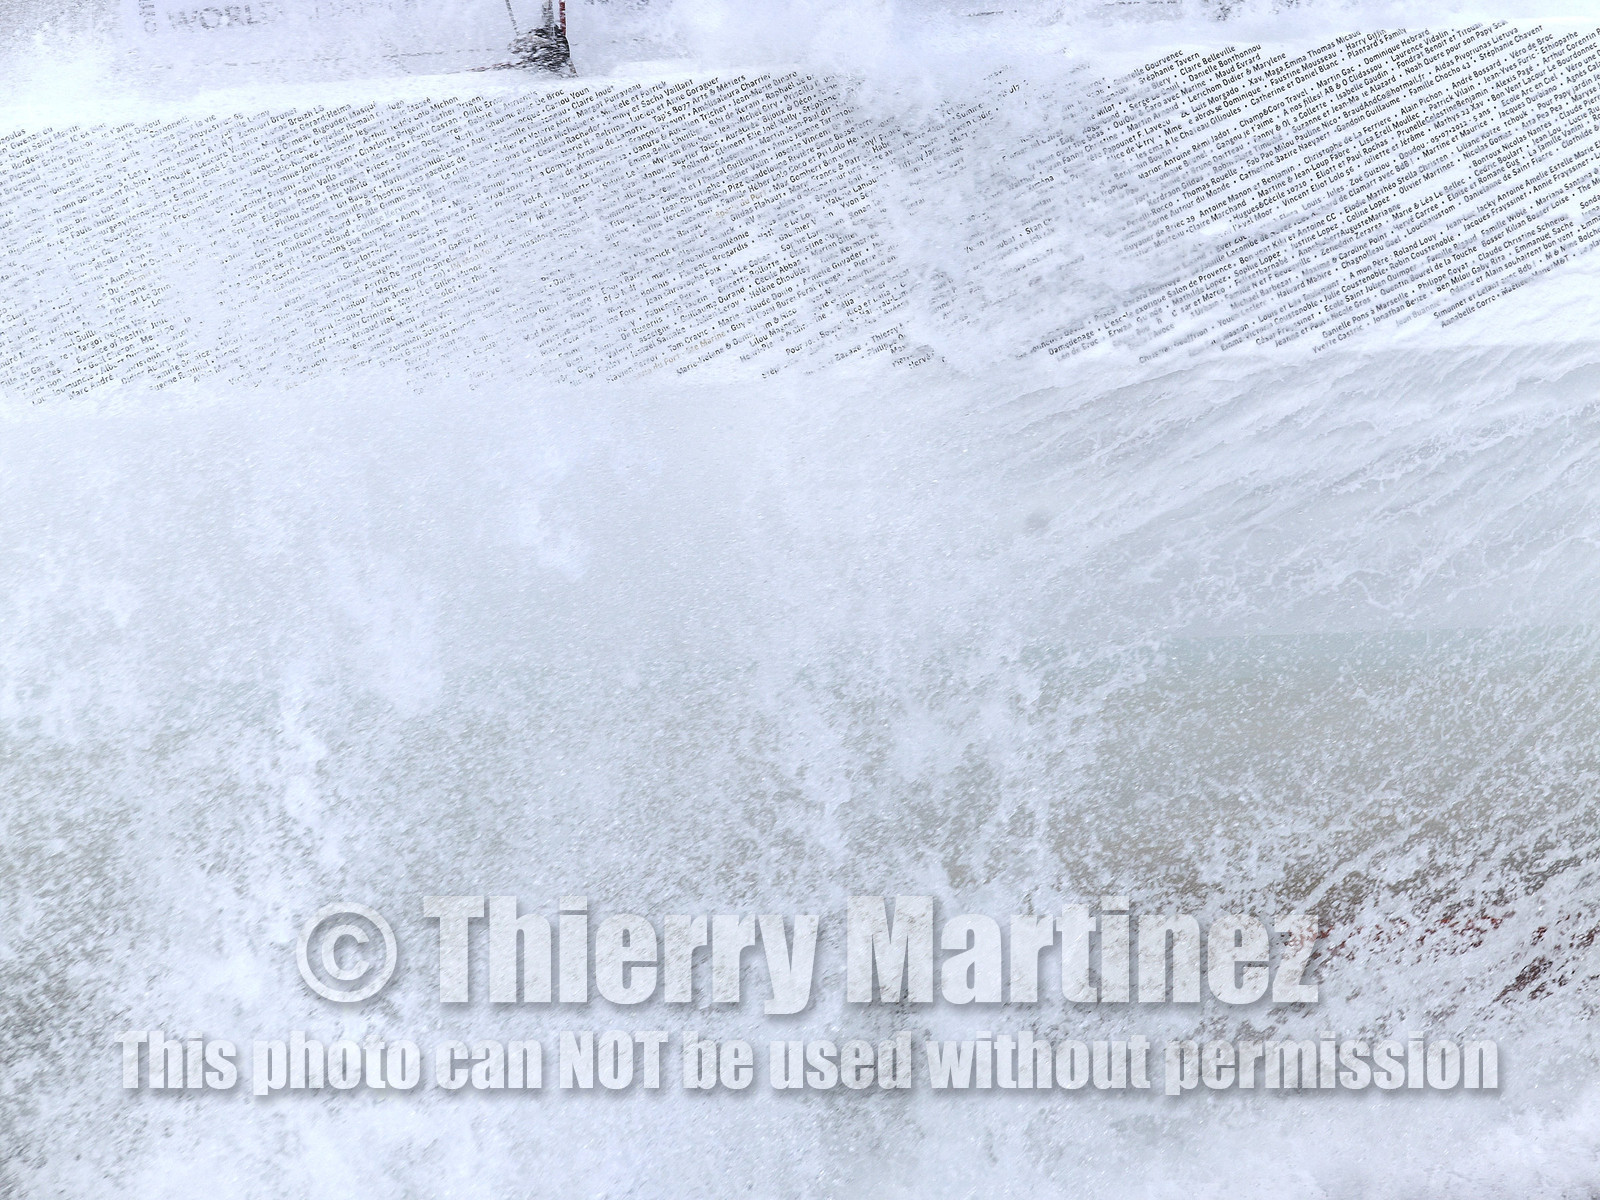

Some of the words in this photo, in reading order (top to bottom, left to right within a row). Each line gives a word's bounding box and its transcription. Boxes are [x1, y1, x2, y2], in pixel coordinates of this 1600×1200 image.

[1144, 49, 1183, 71] Gourvenec
[1173, 52, 1200, 67] Tavern
[1179, 61, 1202, 76] Claire
[1201, 46, 1236, 65] Belleville
[1179, 80, 1206, 96] Marine
[1214, 64, 1236, 80] Maud
[1235, 52, 1261, 70] Evrard
[1187, 64, 1218, 82] Danielle
[1217, 44, 1261, 68] Bonthonnou
[1206, 86, 1239, 105] Morgado
[1306, 41, 1336, 58] Thomas
[1222, 86, 1261, 108] Dominique
[1269, 68, 1301, 86] Faustine
[1300, 51, 1337, 72] Mousseau
[1344, 37, 1367, 53] Harry
[1348, 62, 1383, 83] Clidassou
[1390, 42, 1424, 62] Laurence
[1422, 30, 1449, 45] Vidalin
[1364, 96, 1401, 118] Guillaume
[1408, 79, 1435, 96] Famille
[1434, 66, 1461, 83] Chocho
[1478, 39, 1514, 61] Stéphanie
[1513, 24, 1543, 43] Chavent
[1369, 74, 1397, 94] Alazard
[1404, 61, 1424, 75] Noah
[1444, 42, 1461, 56] pour
[1462, 35, 1476, 46] son
[1474, 26, 1493, 39] Papy
[640, 93, 664, 108] Sacha
[663, 78, 693, 96] Vaillant
[1210, 128, 1231, 143] Jadot
[1284, 87, 1309, 104] Travel
[1315, 73, 1341, 89] Martin
[1340, 65, 1356, 76] Gac
[1363, 43, 1401, 65] Dominique
[1250, 85, 1286, 106] Catherine
[1294, 67, 1319, 84] Daniel
[1317, 59, 1339, 73] Blanc
[1297, 101, 1327, 120] Collette
[1335, 82, 1364, 101] Isabelle
[1363, 70, 1389, 86] Gaudin
[1396, 50, 1424, 69] Fondrat
[1345, 150, 1363, 164] Paul
[1361, 138, 1389, 156] Rochas
[1495, 74, 1517, 90] Alexis
[1542, 48, 1565, 65] Arthur
[1565, 32, 1597, 52] Corentin
[1520, 86, 1534, 97] Arc
[1181, 182, 1211, 199] Thomas
[1210, 168, 1238, 186] Rouelle
[1320, 117, 1338, 130] Nico
[1434, 59, 1455, 73] Aidas
[1490, 27, 1519, 44] Lietuva
[1199, 199, 1227, 218] Antoine
[1227, 187, 1252, 203] Manon
[1303, 141, 1343, 165] Christophe
[1400, 102, 1419, 116] Alain
[1418, 90, 1443, 106] Pichon
[1451, 73, 1473, 90] André
[1472, 58, 1502, 78] Bossard
[1508, 47, 1527, 59] Véro
[1526, 42, 1537, 51] de
[1535, 33, 1554, 46] Broc
[1281, 188, 1310, 207] Vincent
[1327, 171, 1345, 184] Lolo
[1490, 91, 1506, 102] Bon
[1504, 81, 1522, 94] Vent
[1521, 68, 1546, 85] Lacour
[1546, 63, 1557, 73] Le
[1555, 42, 1598, 67] Bourdonnec
[1421, 139, 1451, 158] Martine
[1497, 101, 1526, 119] Jacques
[1210, 198, 1247, 222] Marchand
[1256, 180, 1286, 198] Martine
[1329, 147, 1350, 162] Fabre
[1373, 124, 1393, 139] Erell
[1391, 112, 1420, 130] Moullec
[1427, 94, 1454, 111] Patrick
[1453, 84, 1475, 98] Vilain
[1483, 62, 1518, 84] Jean-Yves
[1516, 52, 1536, 66] Furic
[1471, 148, 1502, 167] Bontoux
[1501, 134, 1527, 152] Nicolas
[1526, 120, 1552, 138] Nantes
[1496, 146, 1523, 164] Boulart
[1368, 195, 1391, 211] Lopez
[1422, 160, 1455, 182] Martinez
[1396, 170, 1418, 185] Stella
[1477, 166, 1506, 185] Romane
[1511, 162, 1531, 176] Saint
[1532, 178, 1553, 193] Annie
[1392, 240, 1419, 258] Roland
[1496, 183, 1524, 202] Antoine
[1548, 156, 1574, 174] Estelle
[1551, 221, 1574, 235] Sache
[1502, 229, 1536, 249] Christine
[1197, 263, 1232, 283] Provence
